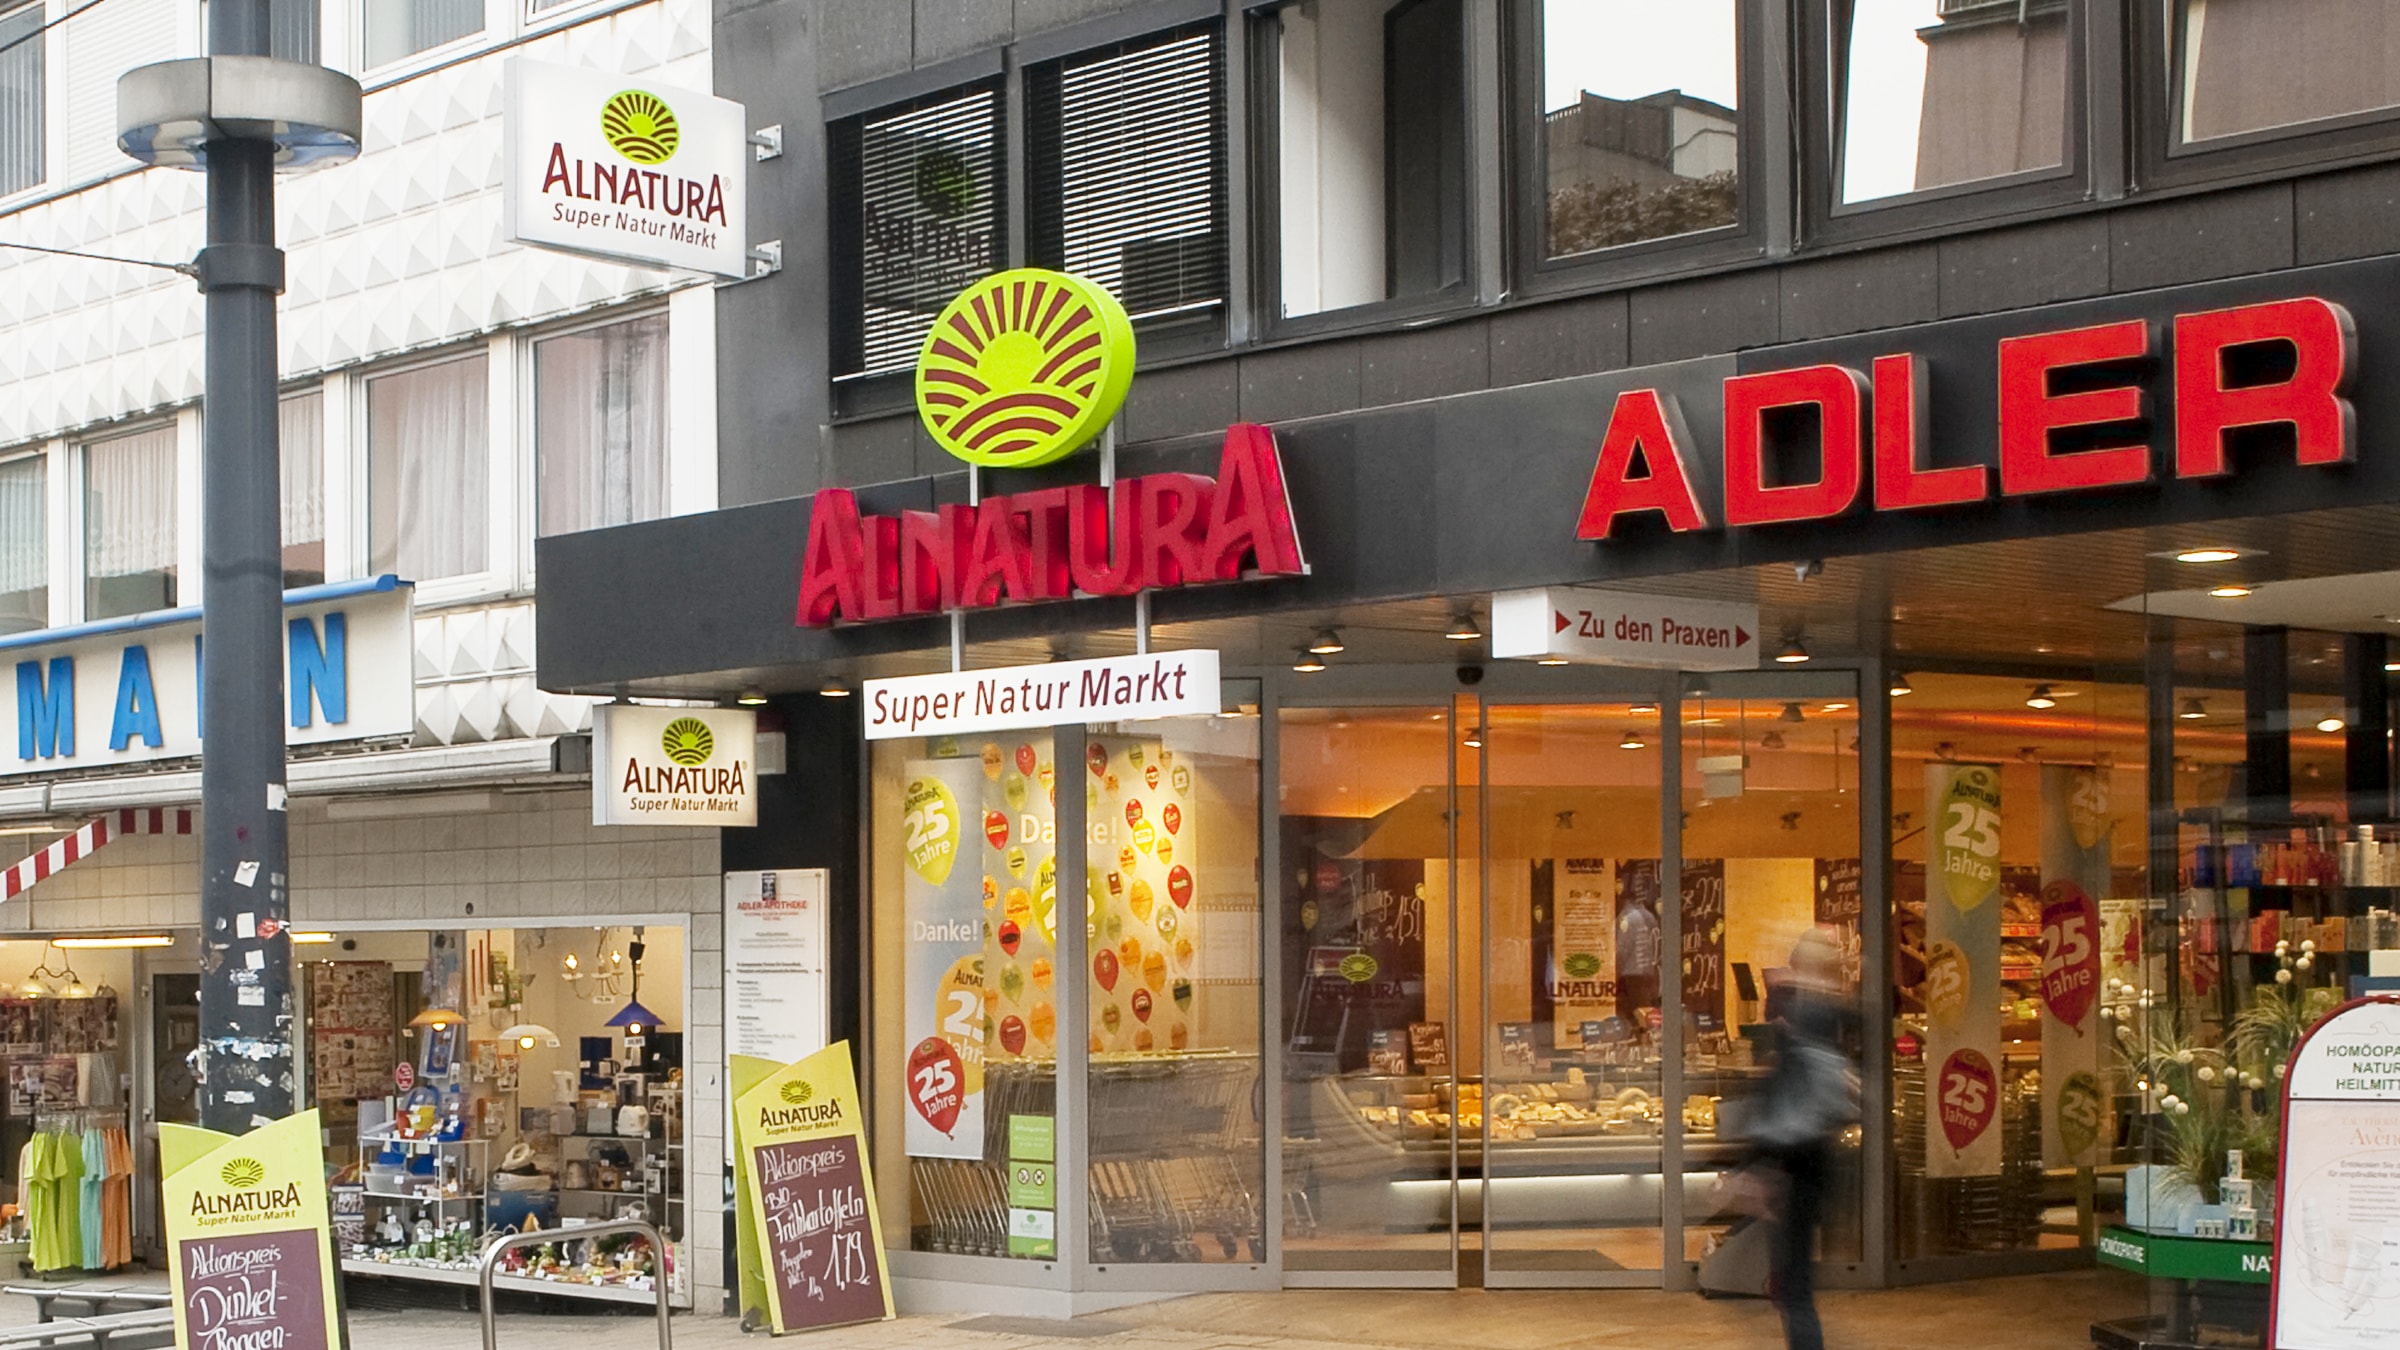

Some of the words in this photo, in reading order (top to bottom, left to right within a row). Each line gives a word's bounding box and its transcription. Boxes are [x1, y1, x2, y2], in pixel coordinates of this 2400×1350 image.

[542, 142, 727, 228] ALNATURA
[552, 202, 610, 229] Super
[615, 211, 666, 238] Natur
[669, 222, 717, 250] Markt
[1575, 296, 2355, 545] ADLER
[796, 422, 1310, 628] ALNATURA
[1578, 611, 1605, 638] Zu
[1614, 615, 1652, 642] den
[1662, 617, 1730, 648] Praxen
[16, 612, 346, 761] MAN
[872, 688, 966, 731] Super
[975, 678, 1070, 716] Natur
[1079, 660, 1187, 708] Markt
[623, 757, 745, 795] ALNATURA
[629, 797, 669, 814] Super
[671, 798, 705, 811] Natur
[706, 798, 739, 812] Markt
[904, 799, 950, 853] 25
[1944, 802, 2000, 858] 25
[913, 840, 951, 870] Jahre
[1943, 851, 1993, 882] Jahre
[914, 919, 978, 941] Danke!
[2042, 916, 2091, 977] 25
[2046, 968, 2091, 1001] Jahre
[914, 1059, 956, 1104] 25
[1943, 1073, 1988, 1114] 25
[760, 1098, 842, 1128] ALNATURA
[924, 1094, 957, 1119] Jahre
[1943, 1106, 1978, 1130] Jahre
[2061, 1091, 2098, 1129] 25
[765, 1126, 789, 1136] Super
[790, 1122, 814, 1132] Natur
[815, 1119, 839, 1130] Markt
[761, 1145, 846, 1184] Aktionspreis
[191, 1182, 301, 1216] ALNATURA
[197, 1215, 229, 1228] Super
[231, 1211, 262, 1224] Natur
[263, 1208, 297, 1221] Markt
[191, 1244, 282, 1279] Aktionspreis
